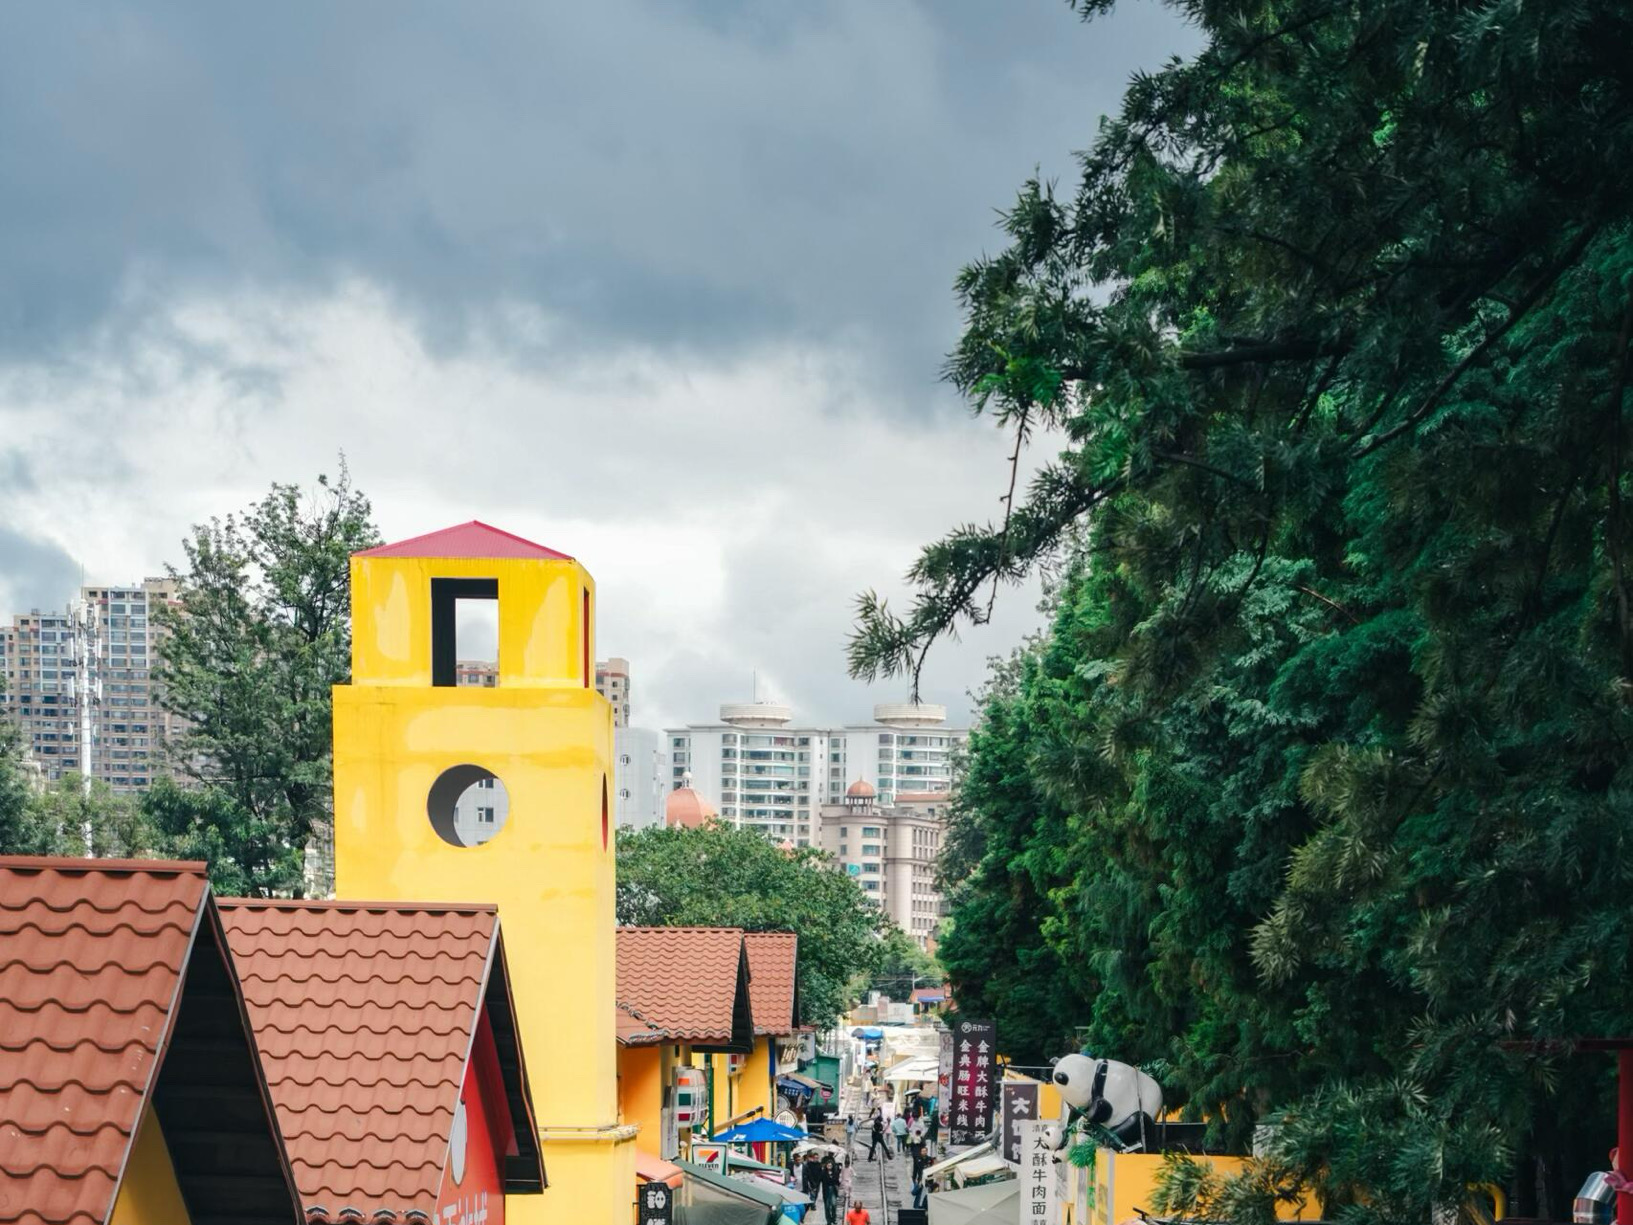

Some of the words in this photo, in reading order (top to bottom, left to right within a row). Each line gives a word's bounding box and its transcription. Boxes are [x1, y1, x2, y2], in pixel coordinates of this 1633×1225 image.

[1032, 1137, 1047, 1215] 大酥牛肉面
